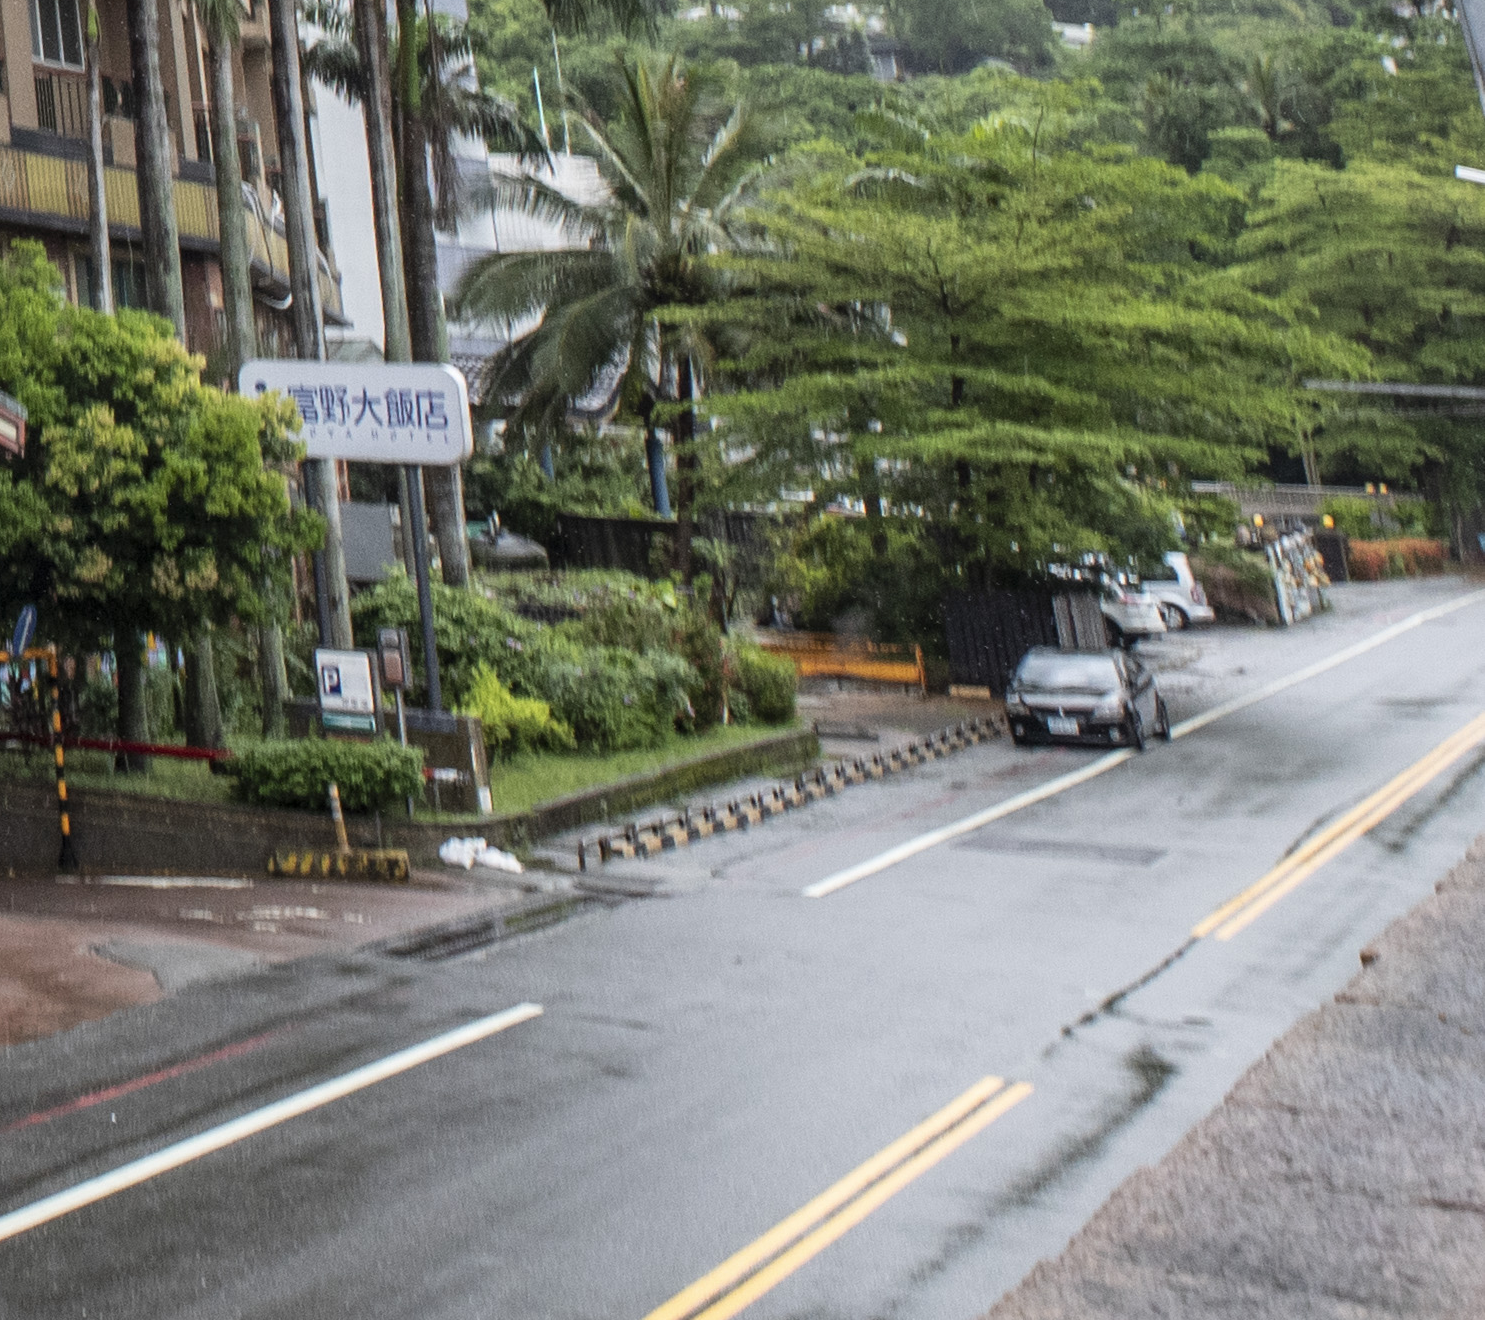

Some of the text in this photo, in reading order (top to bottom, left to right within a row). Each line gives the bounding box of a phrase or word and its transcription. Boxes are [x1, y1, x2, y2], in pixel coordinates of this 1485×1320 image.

[288, 383, 449, 430] 富野大飯店
